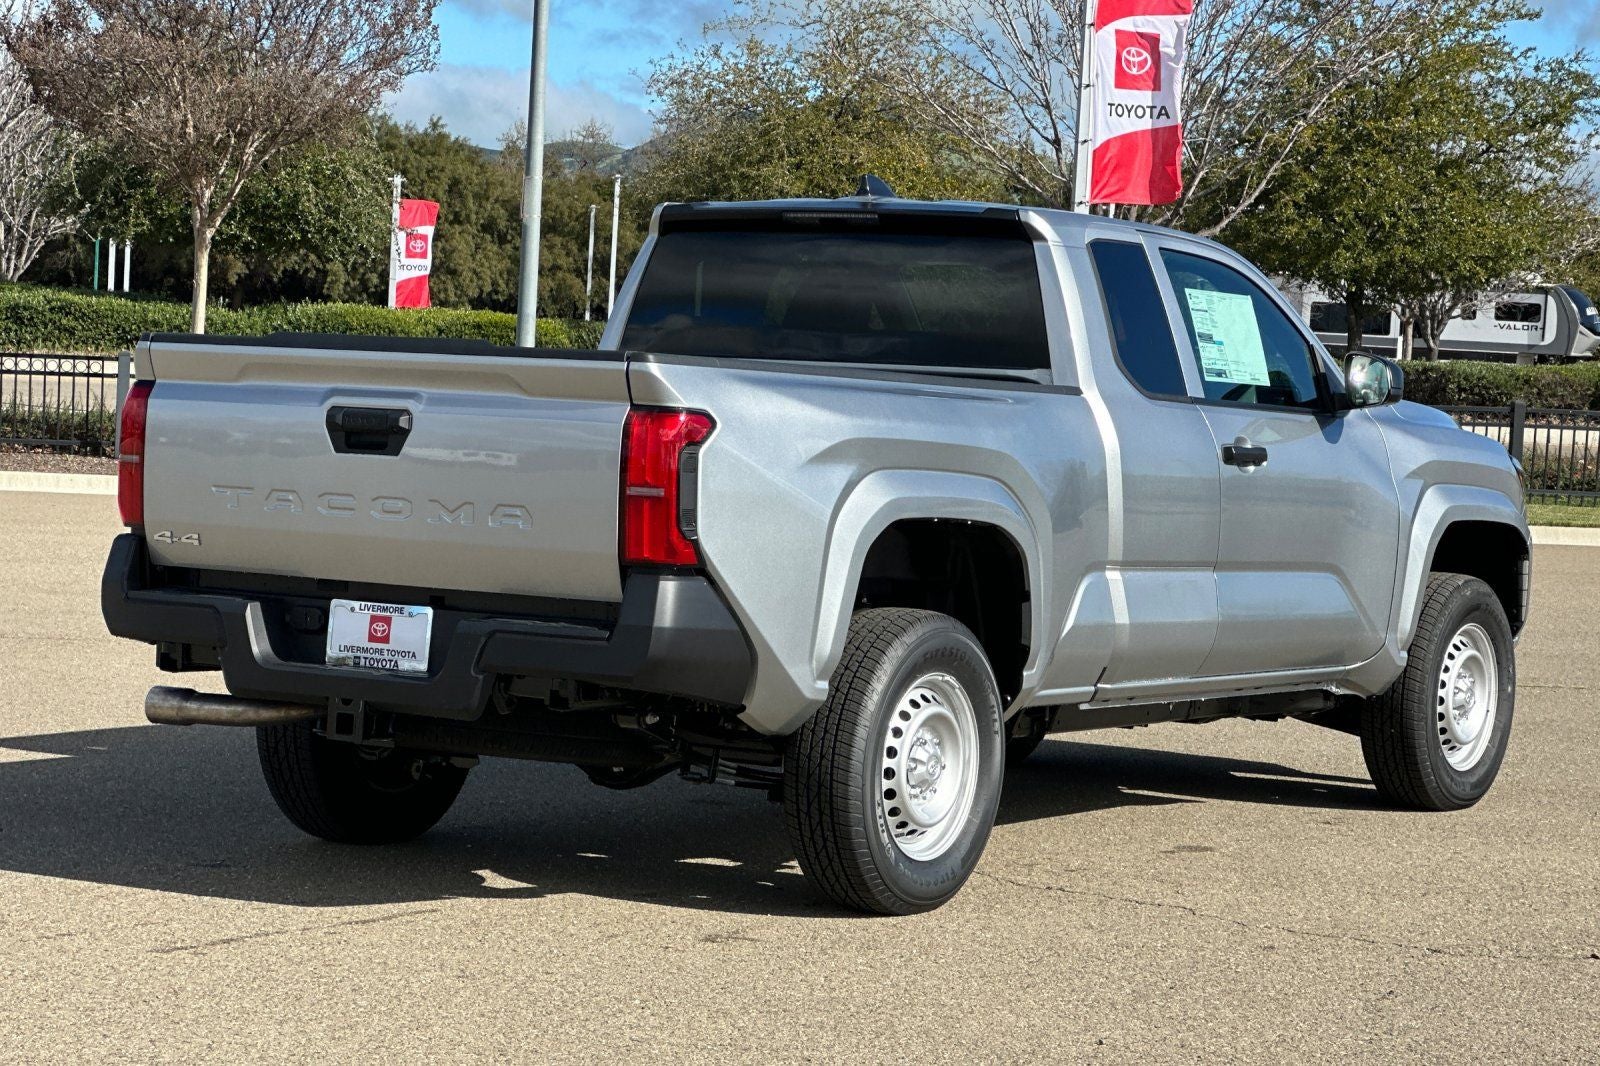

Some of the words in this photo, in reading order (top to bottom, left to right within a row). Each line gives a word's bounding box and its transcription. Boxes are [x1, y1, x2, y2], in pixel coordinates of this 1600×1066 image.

[1107, 103, 1171, 120] TOYOTA
[211, 484, 534, 529] TACOMA
[359, 603, 405, 615] LIVERMORE
[338, 644, 385, 657] LIVERMORE
[386, 650, 417, 660] TOYOTA
[363, 656, 399, 669] TOYOTA
